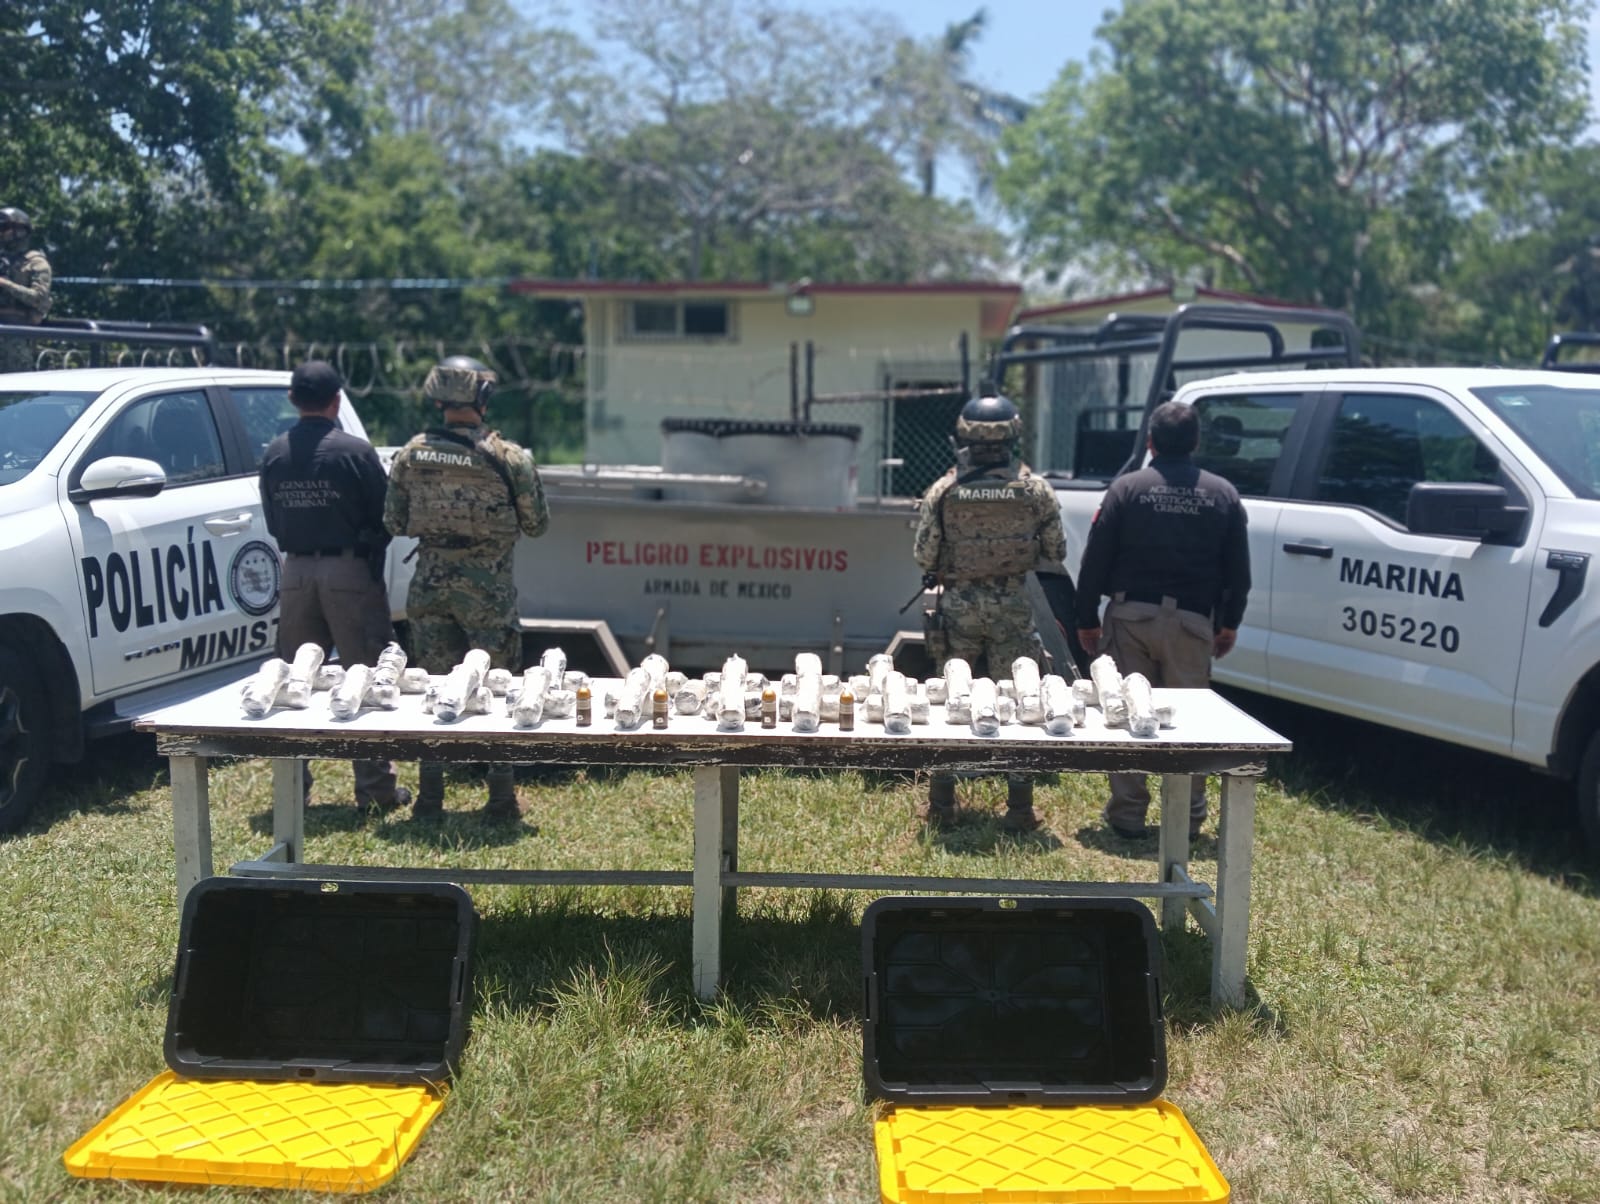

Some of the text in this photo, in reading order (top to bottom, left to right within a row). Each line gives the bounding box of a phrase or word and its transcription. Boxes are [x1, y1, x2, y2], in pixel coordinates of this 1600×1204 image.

[415, 450, 473, 468] MARINA
[958, 487, 1016, 500] MARINA
[1153, 503, 1200, 515] CRIMINAL
[586, 541, 848, 572] PELIGRO EXPLOSIVOS
[81, 526, 225, 637] POLICÍA
[644, 579, 791, 599] ARMADA DE MEXICO
[1340, 557, 1464, 601] MARINA
[1342, 606, 1460, 653] 305220
